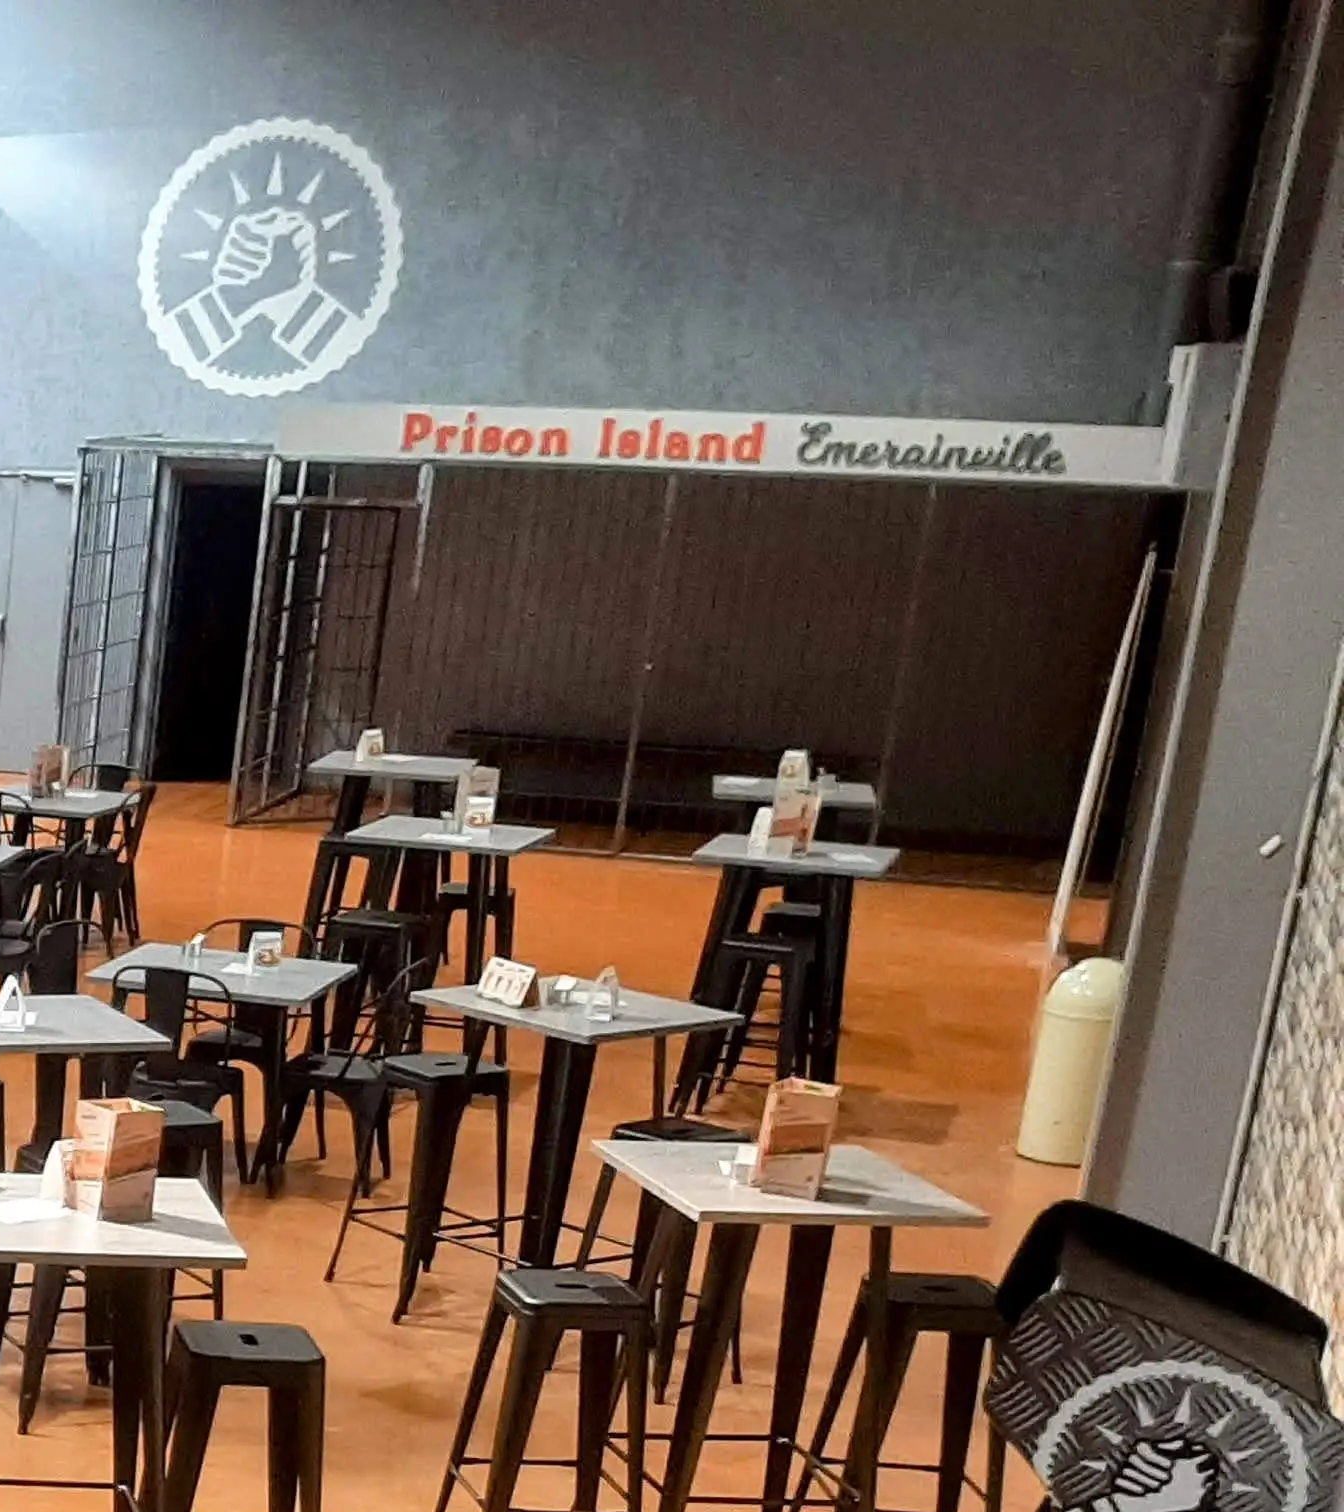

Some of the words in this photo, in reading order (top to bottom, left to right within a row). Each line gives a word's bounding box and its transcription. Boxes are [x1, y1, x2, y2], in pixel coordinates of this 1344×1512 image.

[400, 411, 569, 457] Prison
[598, 417, 766, 464] Island
[796, 421, 1066, 474] Emerainville
